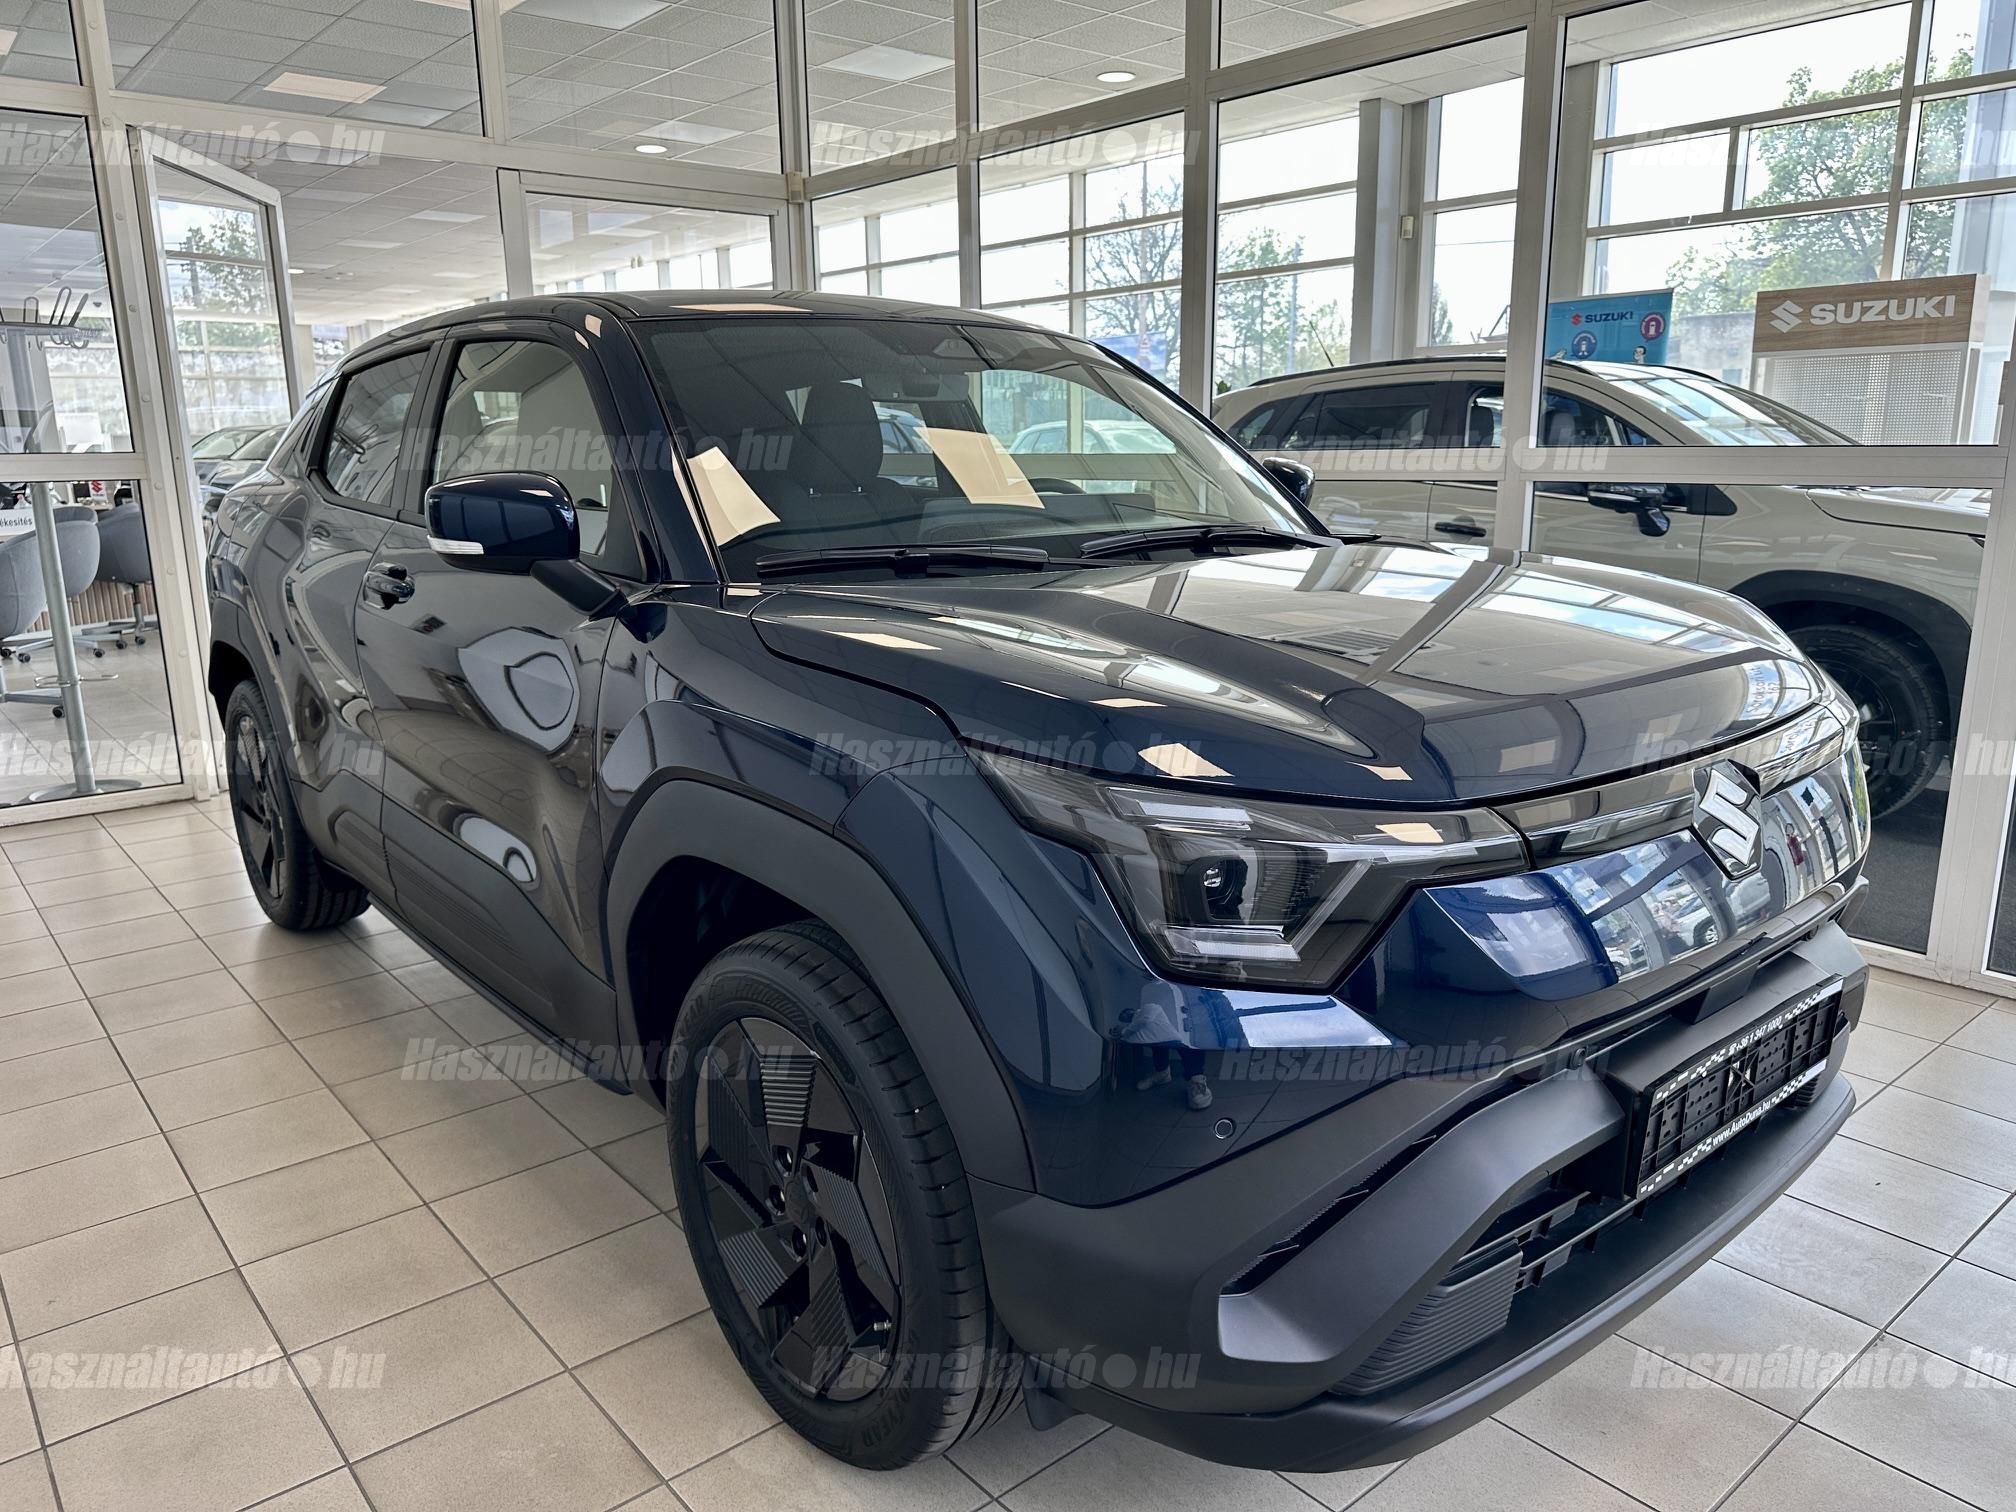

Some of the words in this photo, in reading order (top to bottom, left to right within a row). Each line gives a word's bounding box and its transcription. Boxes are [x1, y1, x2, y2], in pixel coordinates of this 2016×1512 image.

[1585, 311, 1633, 323] SUZUKI
[1810, 295, 1956, 325] SUZUKI
[1712, 1100, 1771, 1146] www.AutoDuna.hu
